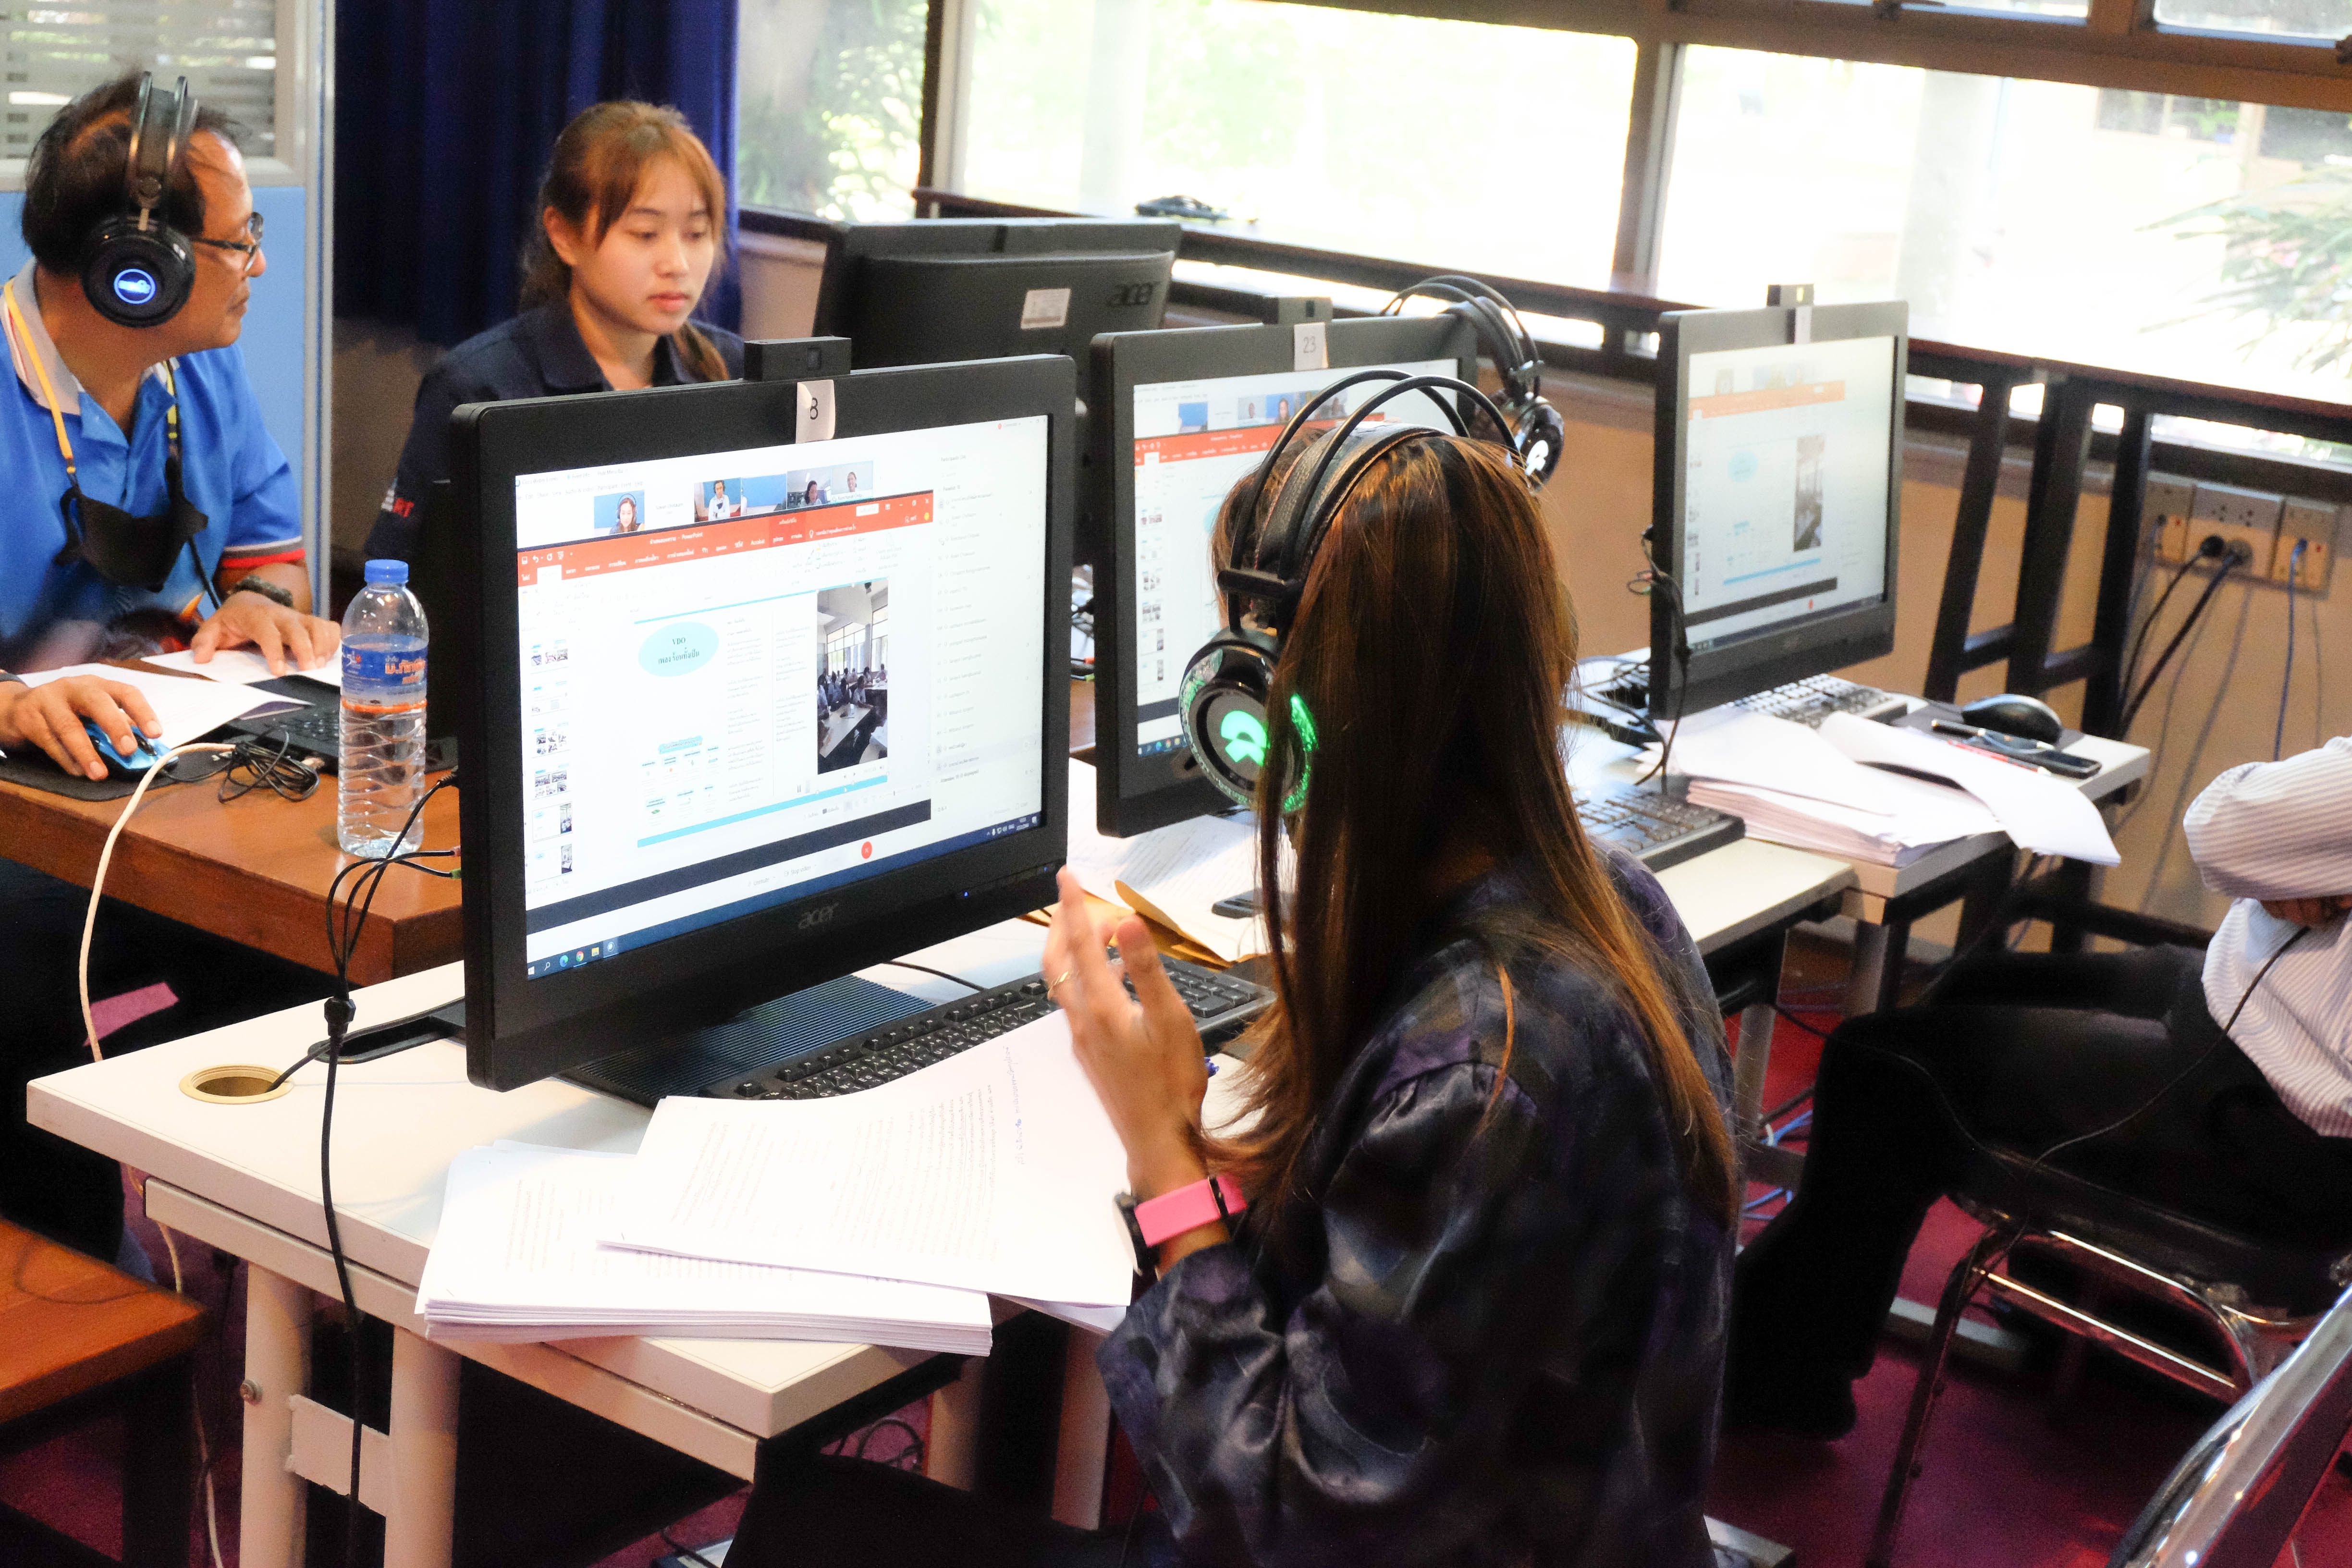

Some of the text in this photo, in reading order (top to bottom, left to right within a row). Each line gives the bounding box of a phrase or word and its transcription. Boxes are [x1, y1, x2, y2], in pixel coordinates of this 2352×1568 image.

[1303, 336, 1316, 354] 23
[810, 397, 819, 420] 8
[681, 532, 703, 540] PowerPoint
[672, 637, 686, 645] VDO
[658, 655, 672, 665] เพลง
[753, 876, 770, 886] Unmute
[798, 902, 839, 930] acer
